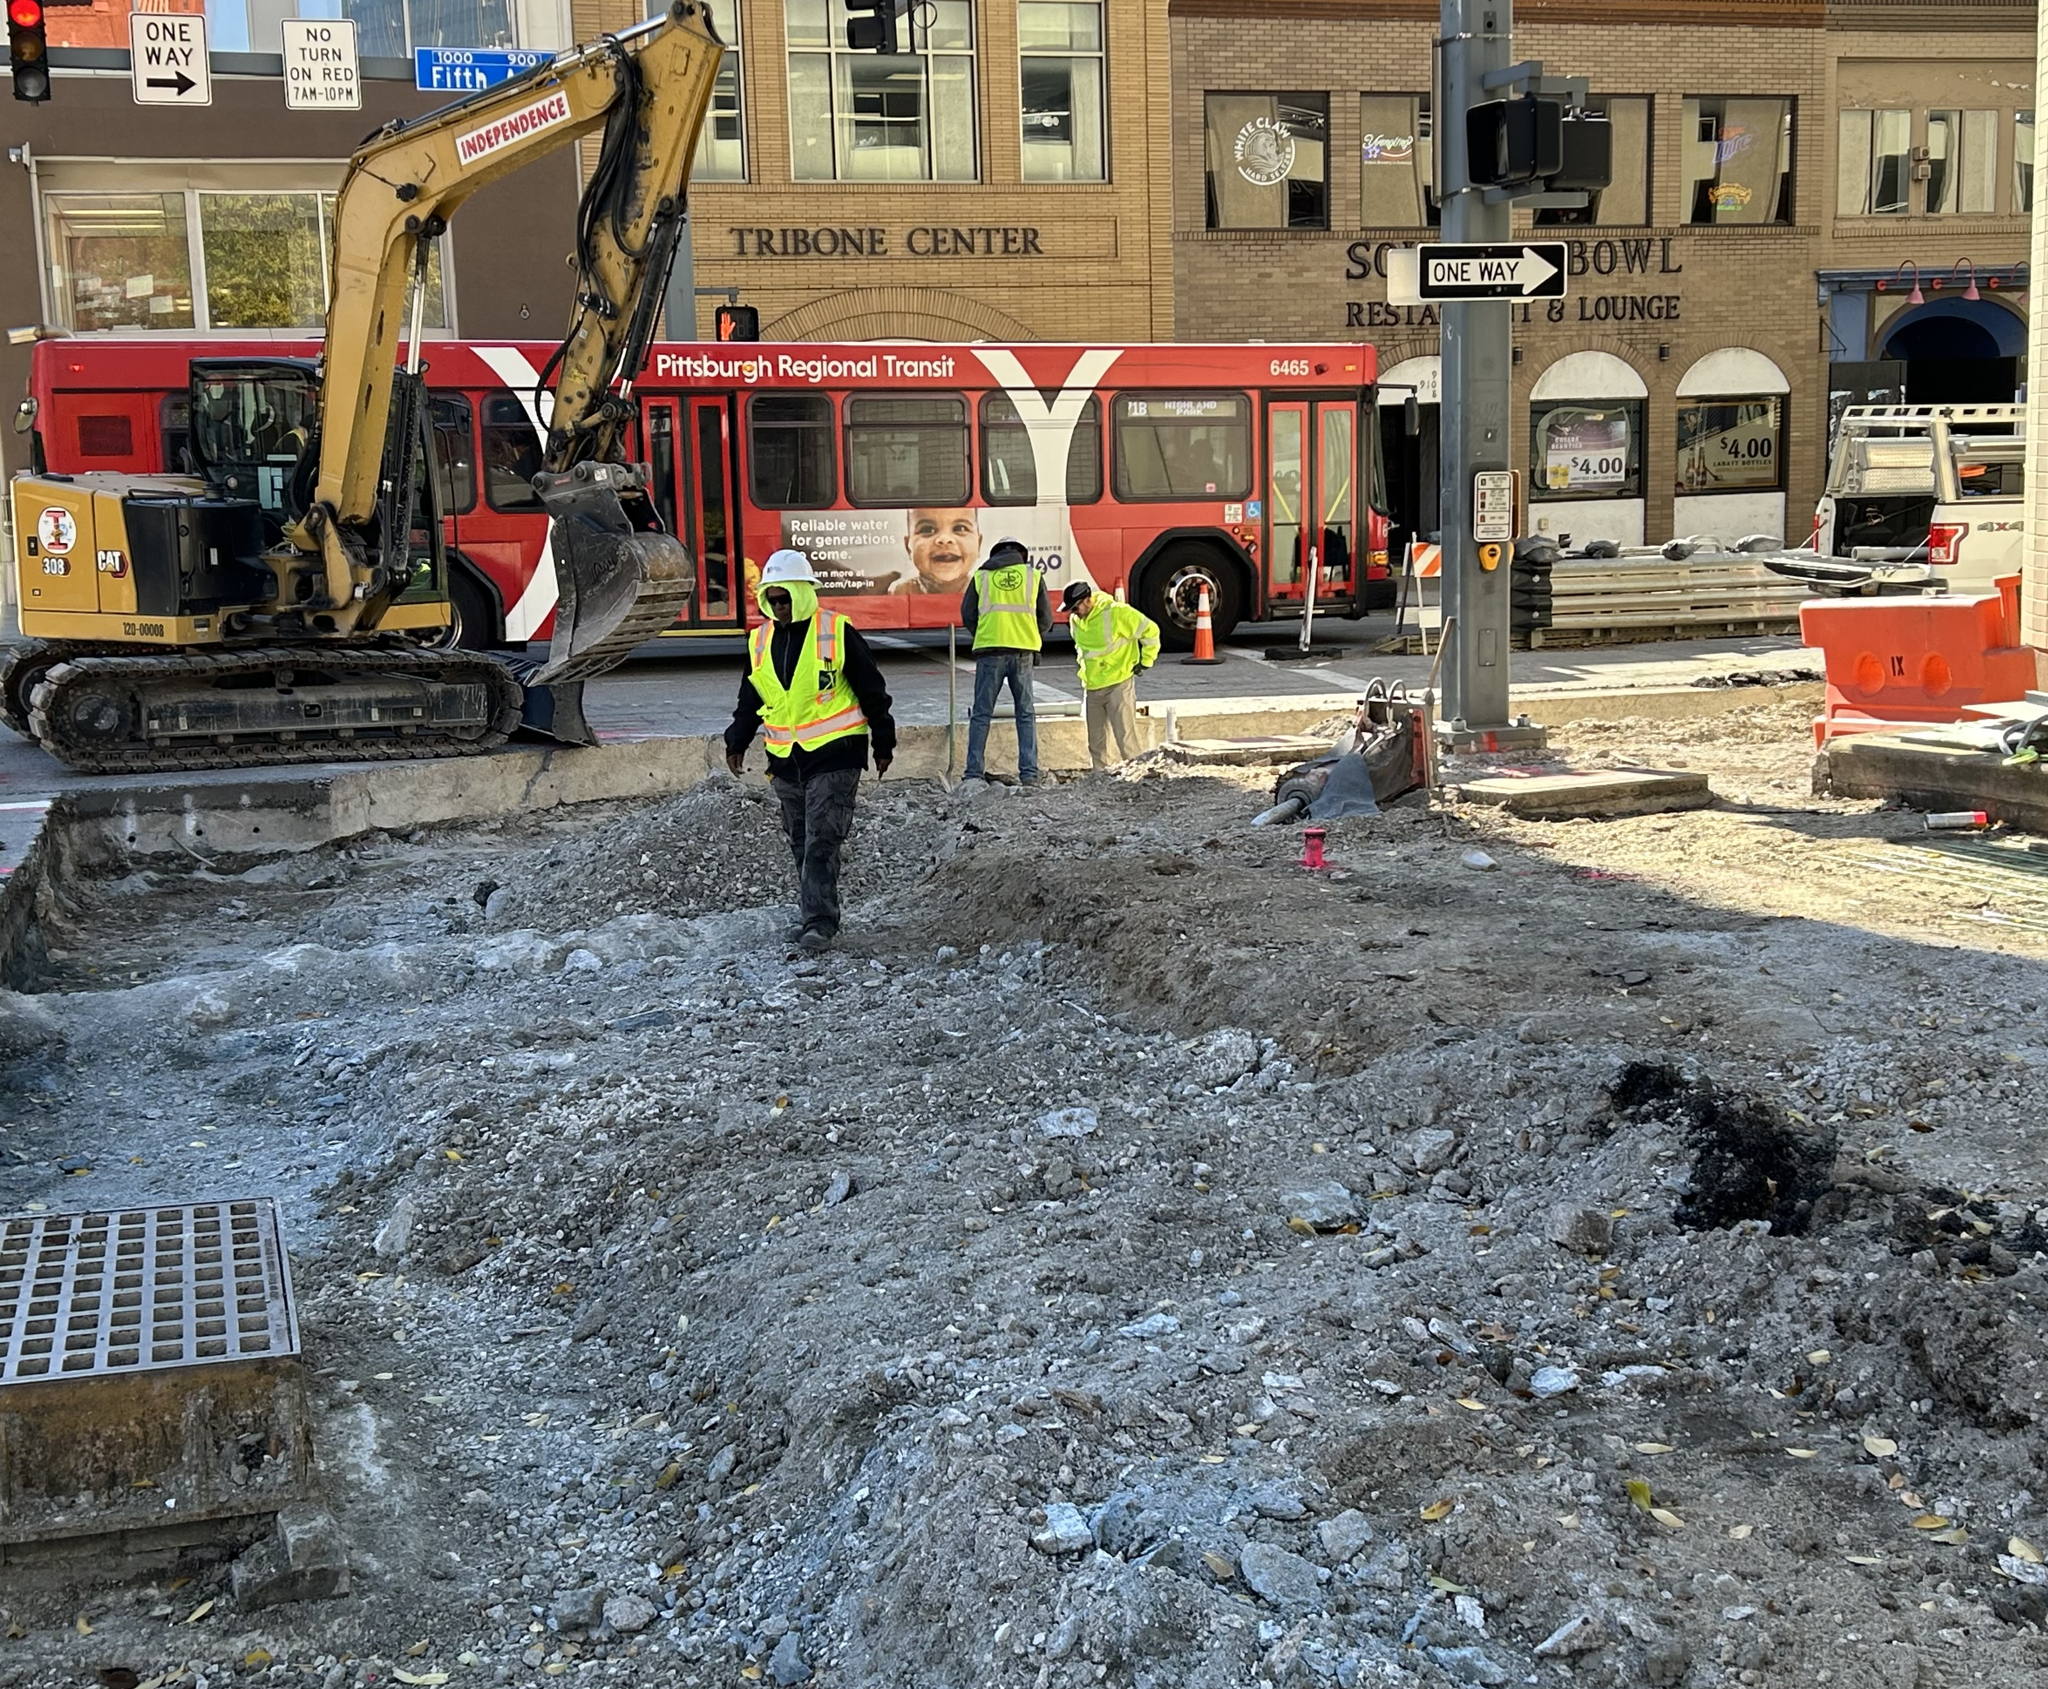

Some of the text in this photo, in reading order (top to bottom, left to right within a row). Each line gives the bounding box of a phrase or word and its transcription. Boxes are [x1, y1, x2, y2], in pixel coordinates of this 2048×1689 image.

[146, 22, 191, 42] ONE
[306, 28, 331, 42] NO
[145, 47, 193, 66] WAY
[299, 48, 342, 62] TURN
[437, 52, 536, 66] 1000 900
[290, 67, 353, 82] ON RED
[432, 66, 487, 89] Fifth
[293, 87, 353, 101] 7AM-10PM
[461, 96, 566, 160] INDEPENDENCE
[1233, 117, 1291, 163] WHITE CLAW
[729, 227, 1044, 256] TRIBONE CENTER
[1565, 237, 1682, 276] BOWL
[1433, 261, 1520, 283] ONE WAY
[1547, 298, 1565, 323] &
[1579, 295, 1681, 322] LOUNGE
[656, 354, 955, 383] Pittsburgh Regional Transit
[1270, 360, 1309, 376] 6465
[1164, 401, 1217, 409] HIGHLAND
[1720, 436, 1772, 459] $4.00
[1571, 456, 1623, 475] $4.00
[791, 520, 889, 532] Reliable water
[791, 533, 896, 548] for generations
[97, 550, 121, 572] CAT
[810, 550, 852, 560] come.
[42, 557, 65, 575] 308
[830, 570, 854, 578] more
[856, 569, 865, 577] at
